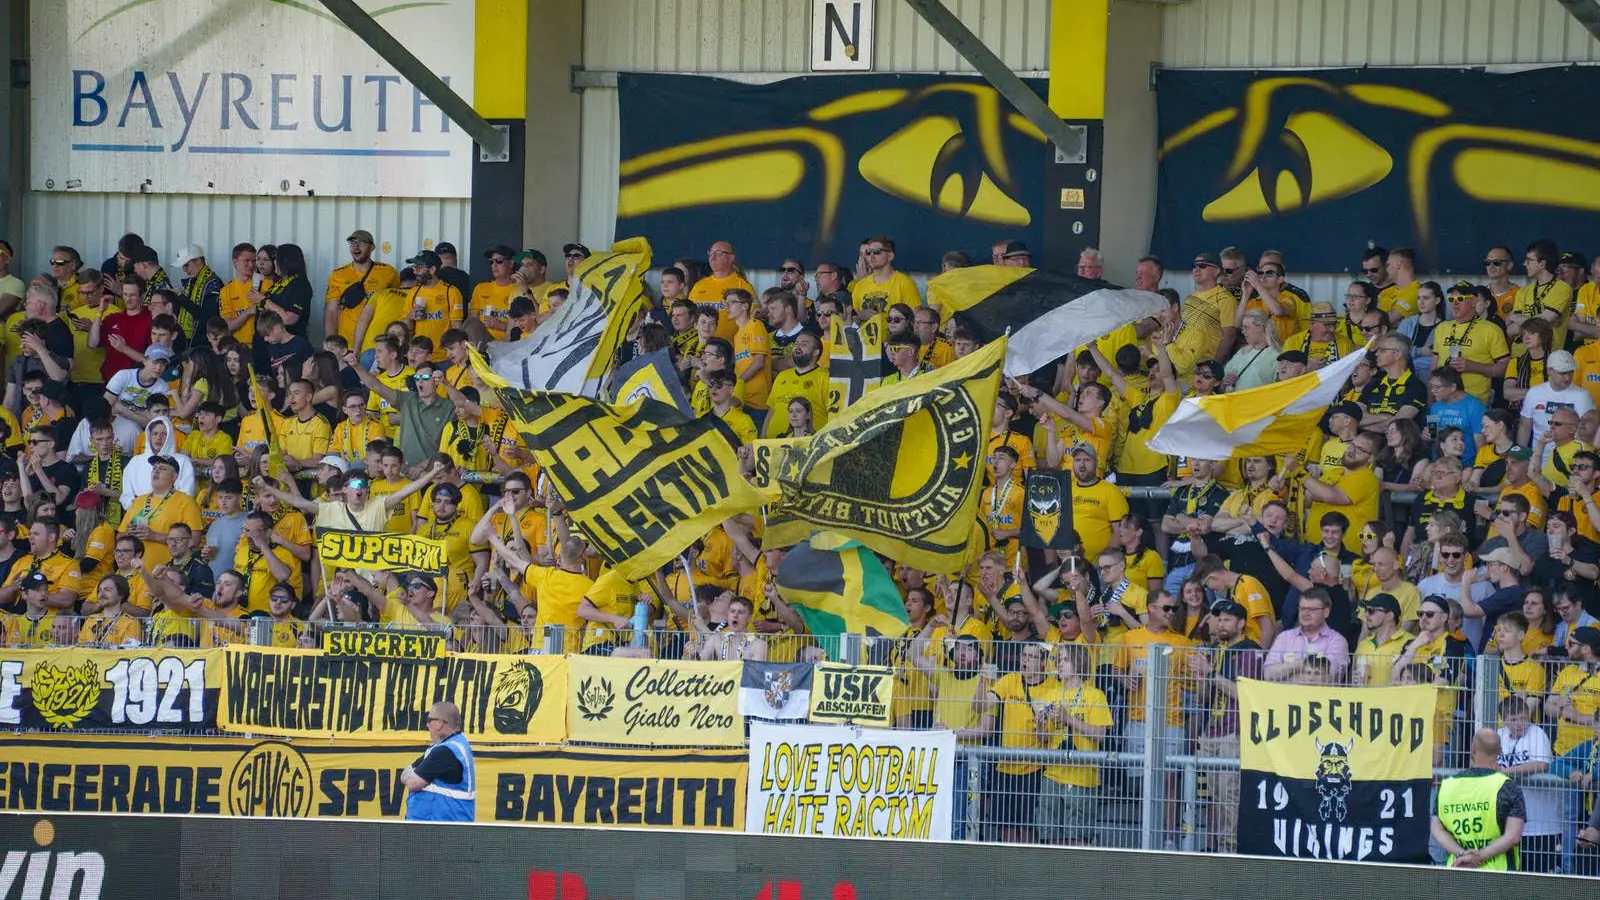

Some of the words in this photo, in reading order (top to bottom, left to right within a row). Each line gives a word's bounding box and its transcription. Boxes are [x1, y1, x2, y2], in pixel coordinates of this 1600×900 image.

[824, 2, 859, 62] N
[322, 531, 441, 572] SUPCREW
[329, 631, 441, 660] SUPCREW
[105, 656, 206, 725] 1921
[225, 650, 381, 733] WAGNERSTADT
[625, 665, 735, 701] Collettivo
[824, 673, 883, 703] USK
[624, 701, 680, 735] Giallo
[688, 703, 734, 730] Nero
[816, 701, 887, 716] ABSCHAFFEN
[760, 741, 823, 793] LOVE
[825, 744, 939, 798] FOOTBALL
[495, 772, 737, 828] BAYREUTH
[763, 792, 828, 835] HATE
[834, 796, 935, 840] RACISM
[1256, 779, 1290, 811] 19
[1379, 787, 1415, 819] 21
[1443, 801, 1490, 814] STEWARD
[1273, 818, 1395, 862] VIKINGS
[1452, 817, 1483, 836] 265
